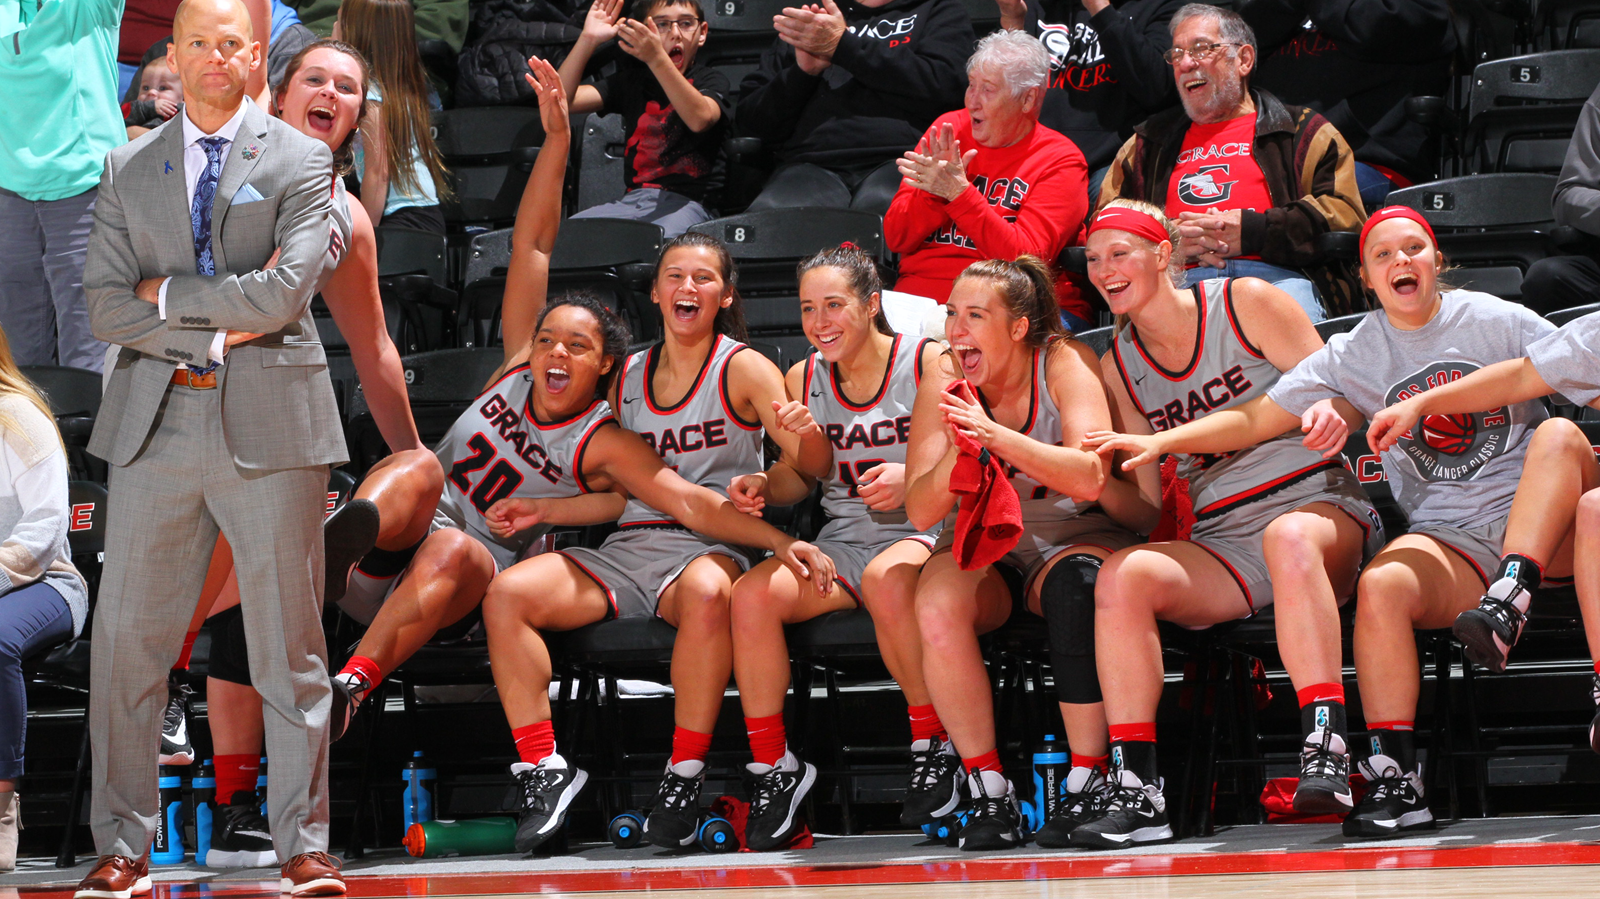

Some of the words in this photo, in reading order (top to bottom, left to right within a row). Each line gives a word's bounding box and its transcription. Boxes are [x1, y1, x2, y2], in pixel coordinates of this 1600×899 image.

[725, 1, 735, 15] 9
[1520, 67, 1530, 82] 5
[1176, 142, 1250, 164] GRACE
[1433, 194, 1444, 209] 5
[735, 227, 745, 242] 8
[404, 369, 415, 385] 9
[1146, 364, 1253, 433] GRACE
[479, 393, 563, 485] GRACE
[818, 416, 912, 450] RACE
[1409, 445, 1437, 471] GRACE
[447, 431, 524, 518] 20
